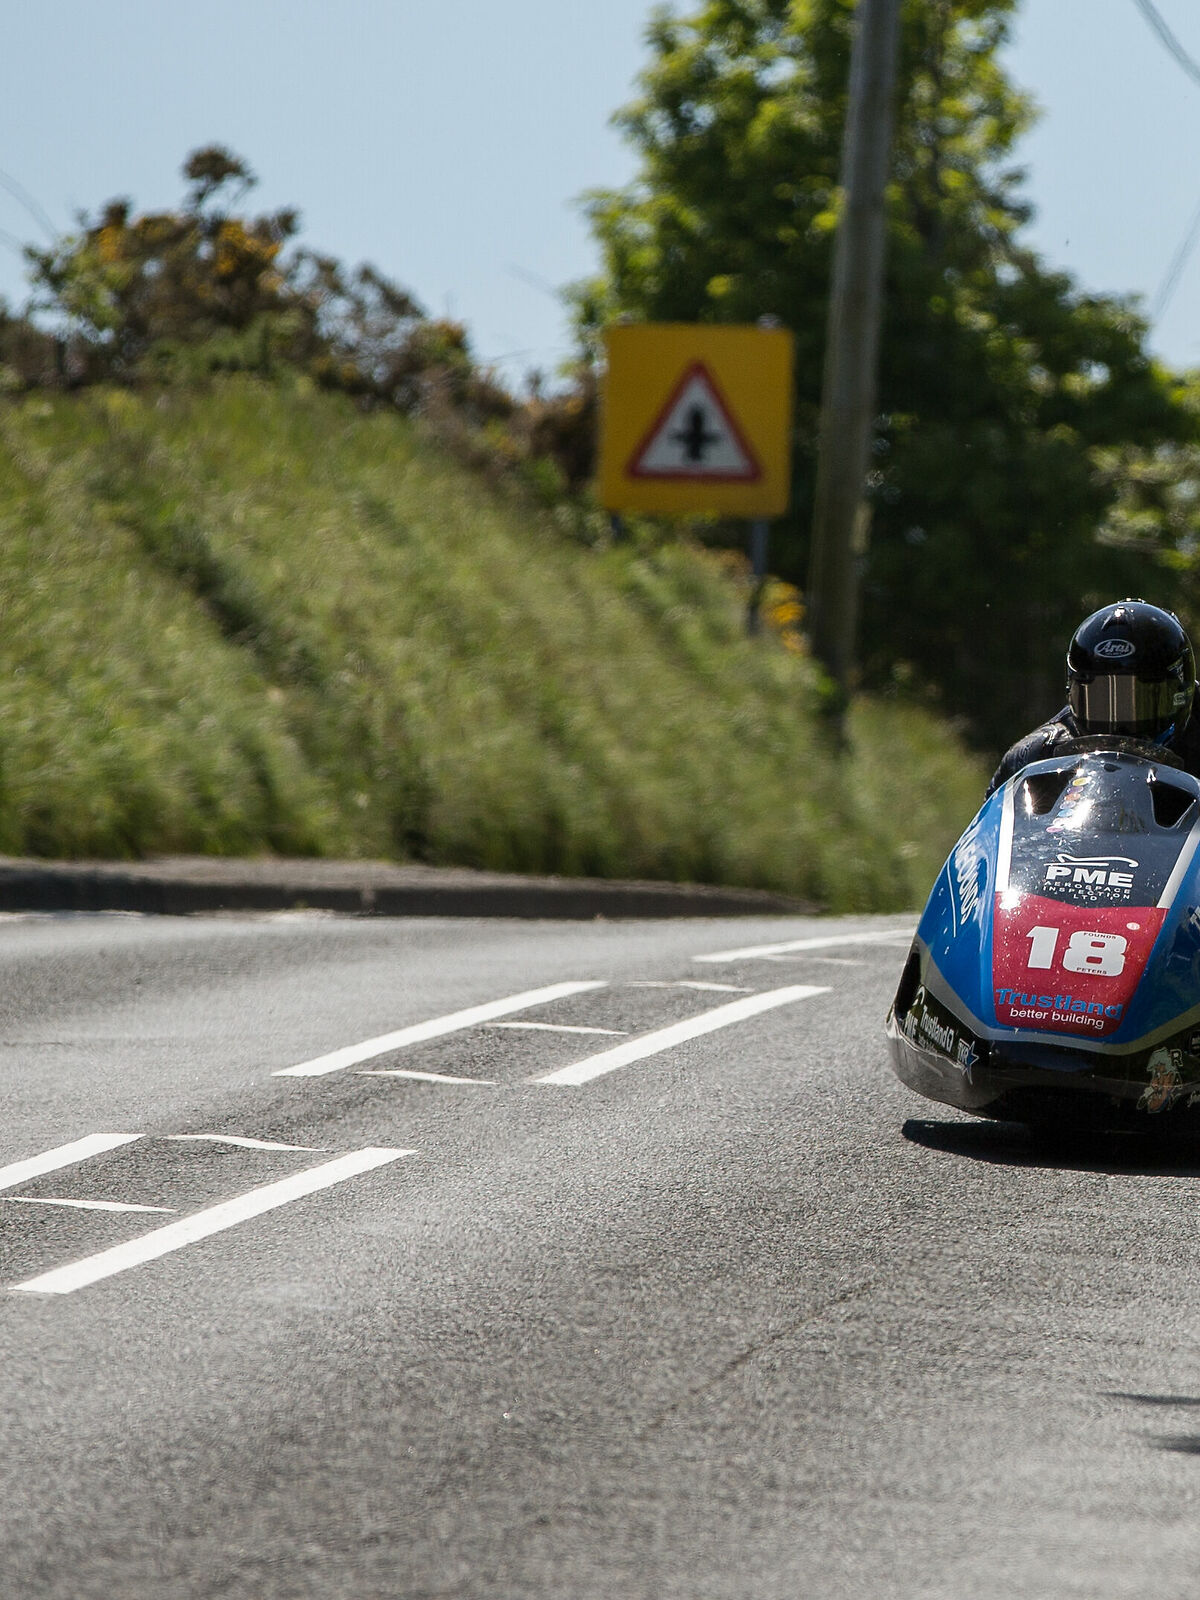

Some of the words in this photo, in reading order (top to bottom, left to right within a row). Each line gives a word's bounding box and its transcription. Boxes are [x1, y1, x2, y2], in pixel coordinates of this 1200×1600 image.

[1098, 641, 1130, 654] Arai
[1045, 866, 1134, 888] PME
[1043, 886, 1131, 900] INSPECTION
[1044, 881, 1131, 895] AEROSPACE
[1083, 932, 1117, 940] FOUNDS
[1026, 925, 1127, 977] 18
[1076, 967, 1107, 975] PETERS
[995, 988, 1123, 1019] Trustland
[1010, 1007, 1048, 1020] better
[1052, 1011, 1104, 1029] building
